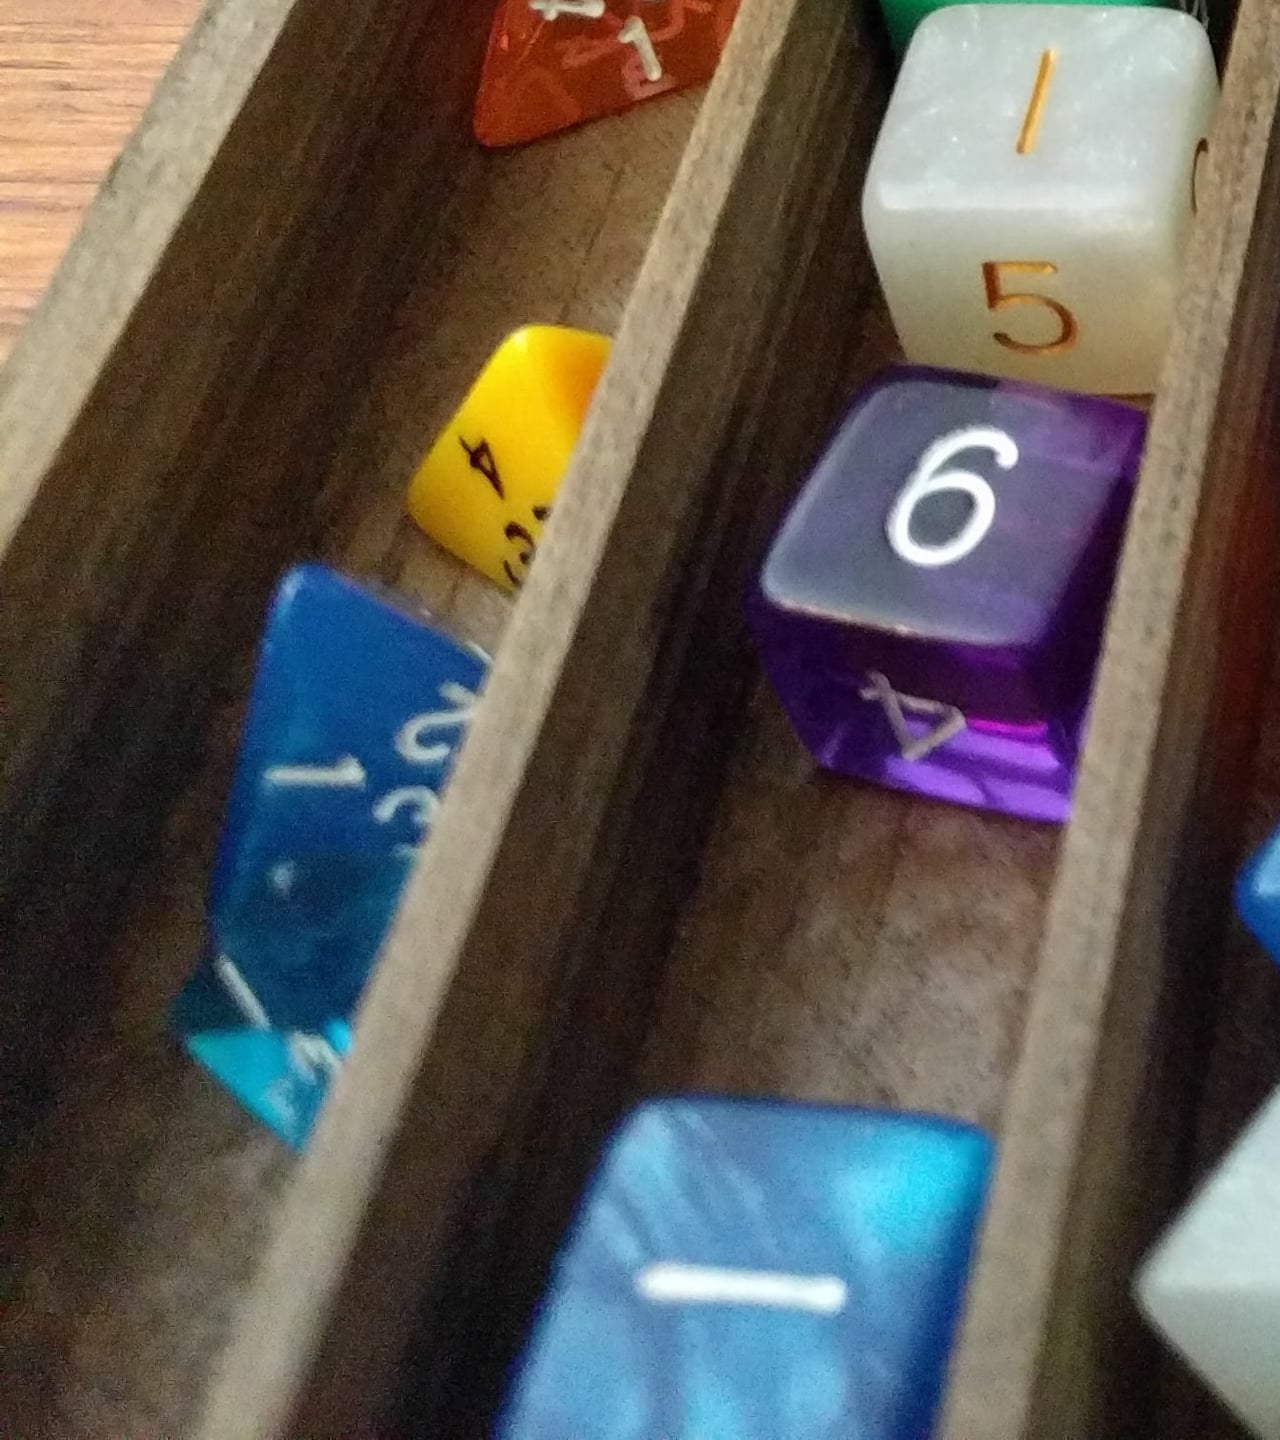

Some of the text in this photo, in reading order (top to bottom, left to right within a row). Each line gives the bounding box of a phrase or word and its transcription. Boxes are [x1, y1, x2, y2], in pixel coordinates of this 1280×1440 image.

[618, 16, 662, 81] 1
[1016, 49, 1057, 154] 1
[981, 260, 1077, 355] 5
[458, 437, 505, 500] 4
[886, 423, 1020, 568] 6
[859, 670, 967, 763] 4
[264, 755, 367, 793] 1
